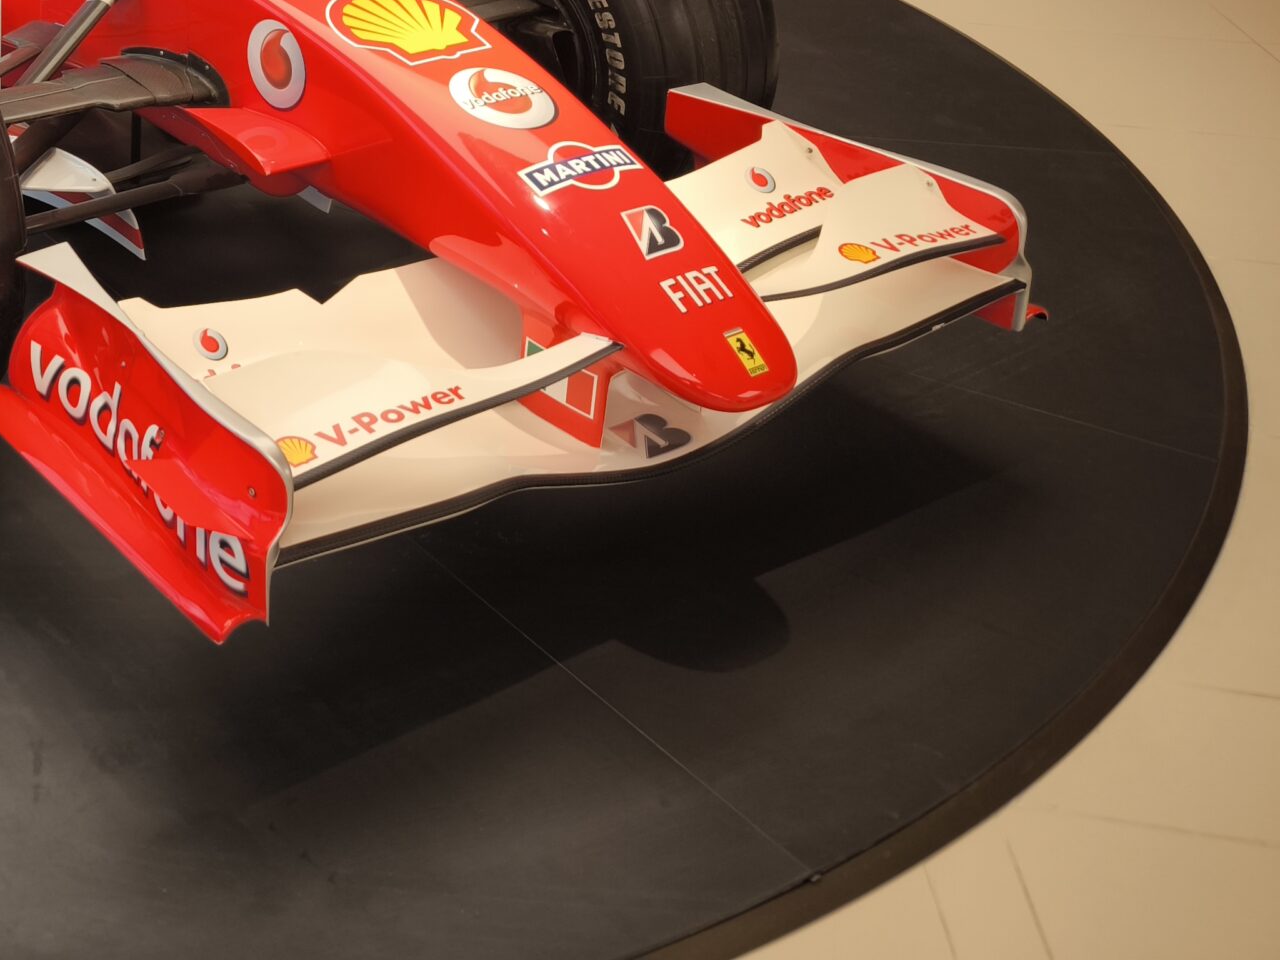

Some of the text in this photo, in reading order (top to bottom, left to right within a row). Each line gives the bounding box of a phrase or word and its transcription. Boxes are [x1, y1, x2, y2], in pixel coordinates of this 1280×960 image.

[462, 84, 543, 110] vodafone
[532, 149, 632, 188] MARTINI
[740, 186, 835, 228] vodafone
[870, 223, 977, 253] V-Power
[659, 265, 734, 314] FIAT
[314, 385, 466, 447] V-Power
